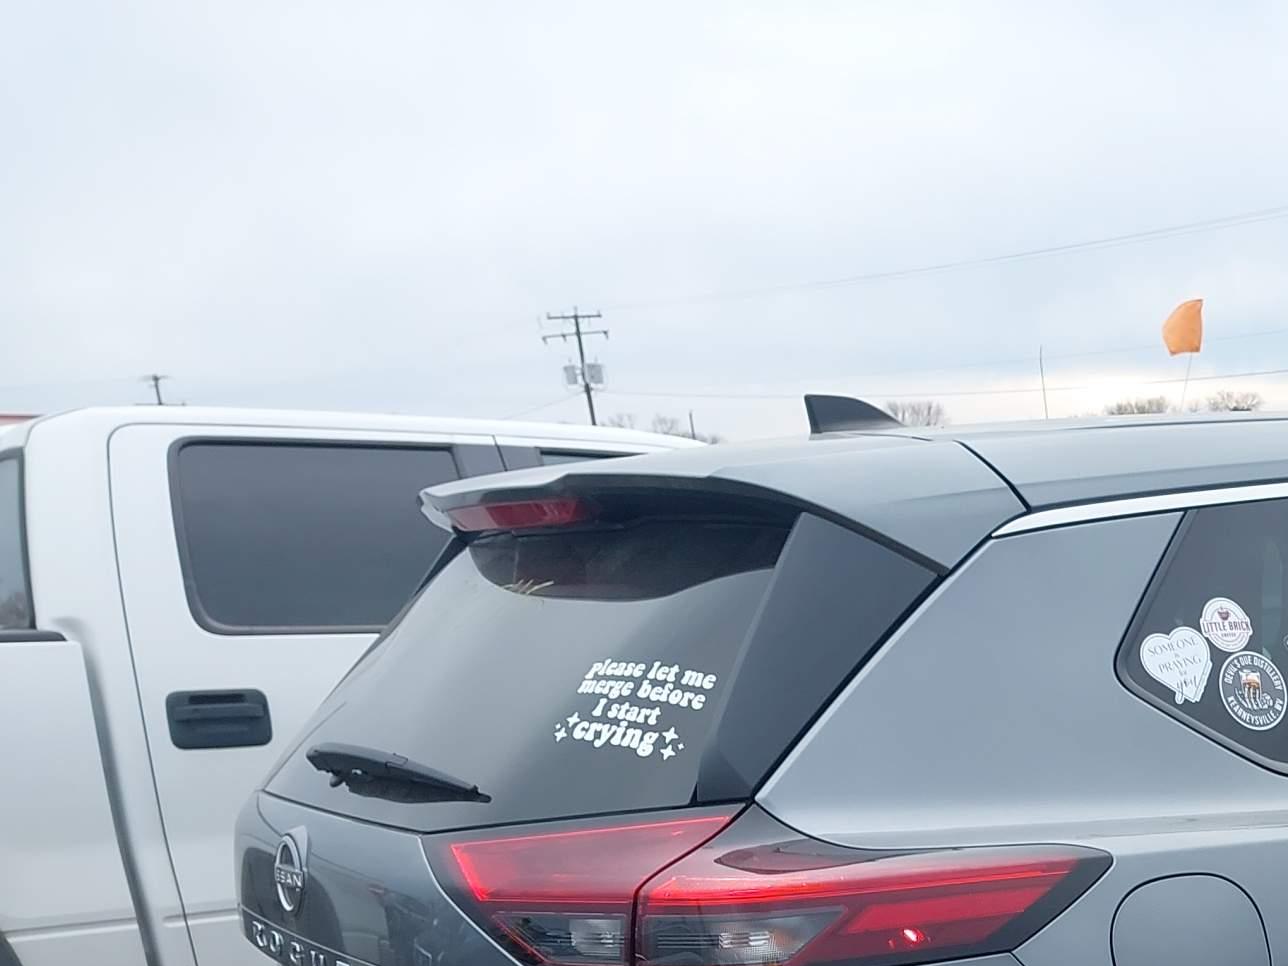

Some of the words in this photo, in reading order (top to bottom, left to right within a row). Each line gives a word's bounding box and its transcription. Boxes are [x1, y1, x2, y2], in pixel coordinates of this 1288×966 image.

[1202, 621, 1227, 633] LITTLE
[1228, 620, 1249, 631] BRICK
[584, 658, 646, 680] please
[647, 661, 680, 682] let
[680, 668, 718, 690] me
[1239, 655, 1252, 666] DUE
[1253, 656, 1283, 690] DISTILLERY
[577, 678, 634, 699] merge
[636, 680, 706, 710] before
[592, 698, 607, 717] I
[607, 701, 661, 725] start
[572, 720, 659, 757] crying
